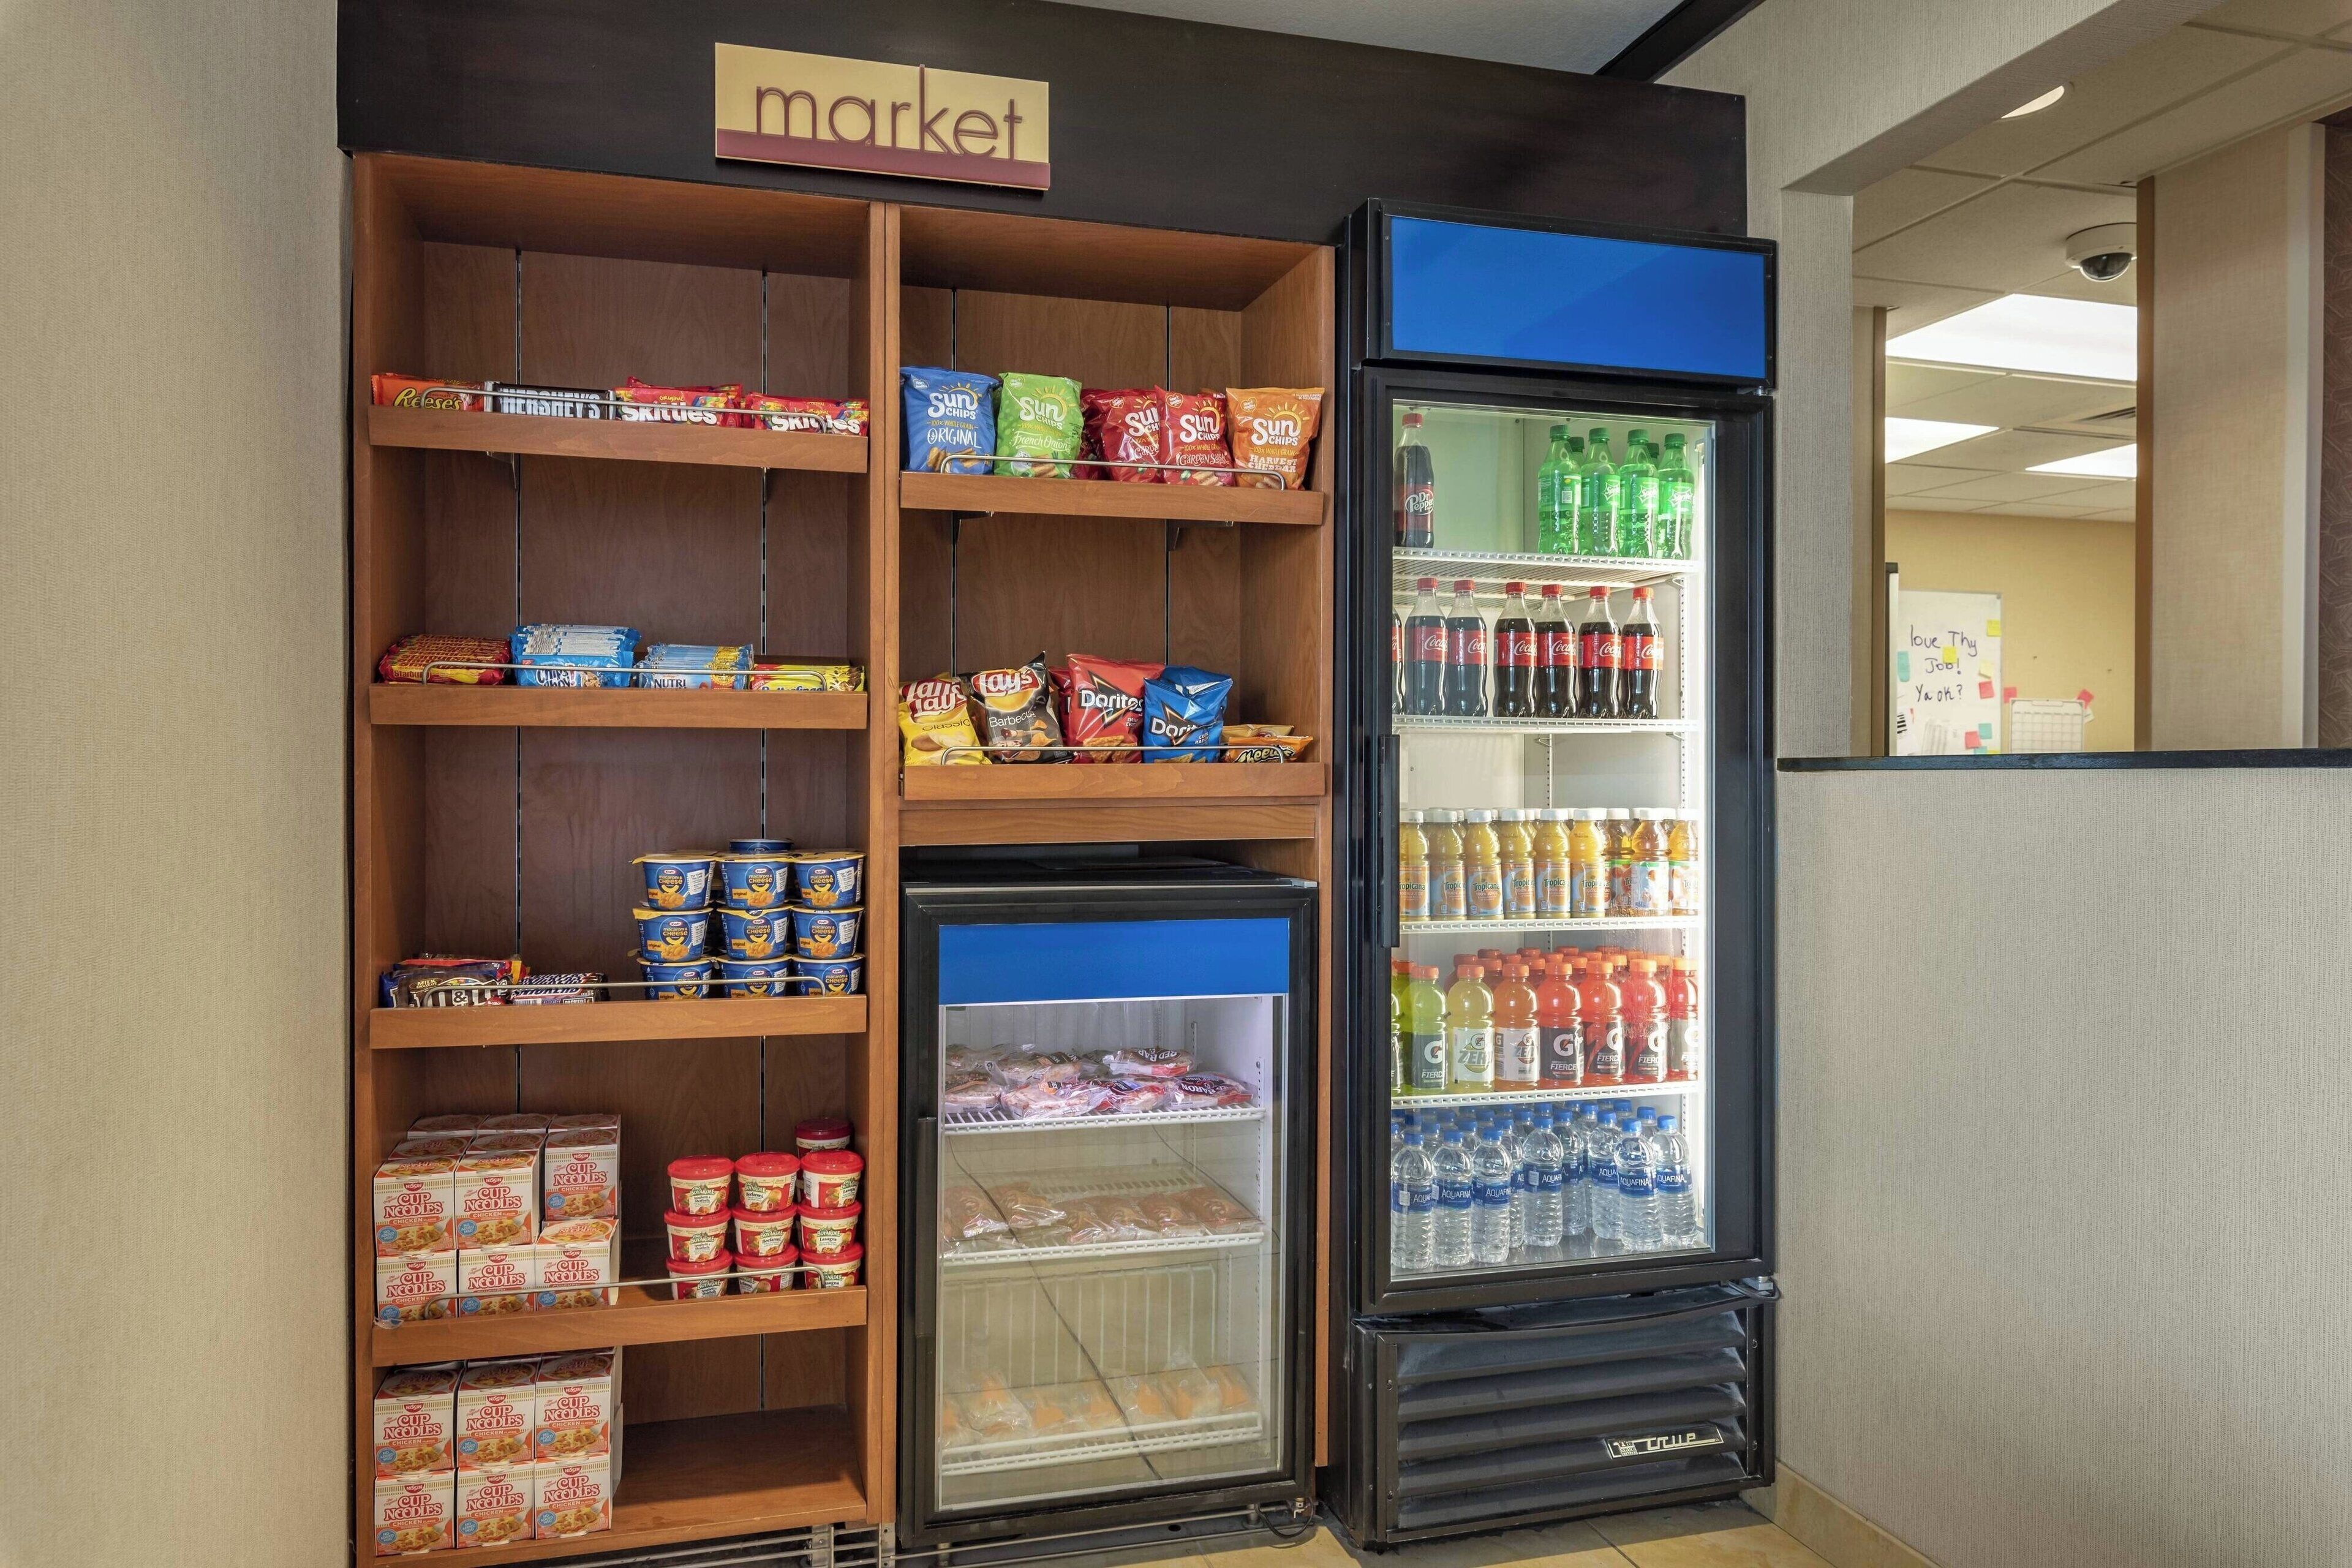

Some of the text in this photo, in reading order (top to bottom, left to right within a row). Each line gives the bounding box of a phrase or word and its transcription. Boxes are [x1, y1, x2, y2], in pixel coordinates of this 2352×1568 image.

[756, 64, 1023, 161] market
[499, 388, 600, 420] HERSHEY'S
[927, 392, 978, 418] Sun
[1019, 396, 1067, 422] Sun
[945, 407, 976, 420] CHIPS
[1036, 415, 1063, 430] CHIPS
[1180, 414, 1220, 443] Sun
[927, 428, 982, 448] ORIGINAL
[1251, 418, 1302, 446] Sun
[1268, 436, 1298, 447] CHIPS
[1248, 462, 1297, 473] CHEDDAR
[1249, 454, 1298, 466] HARVEST
[1419, 492, 1430, 502] Dr
[1948, 631, 1978, 657] Thy
[394, 669, 426, 678] Starbu
[654, 678, 686, 688] NUTRI
[1080, 690, 1144, 713] Doritos
[988, 710, 1036, 728] Barbecue
[1152, 717, 1198, 737] Dorit
[1553, 1034, 1577, 1057] G
[566, 1162, 597, 1175] CUP
[553, 1170, 607, 1186] NOODLES
[1620, 1176, 1651, 1186] AQUAFINA
[398, 1192, 431, 1205] CUP
[478, 1186, 511, 1199] CUP
[1413, 1194, 1431, 1204] AQUAF
[1485, 1188, 1510, 1199] AQUAFIN
[384, 1201, 443, 1218] NOODLES
[464, 1196, 522, 1212] NOODLES
[481, 1264, 514, 1276] CUP
[557, 1259, 589, 1272] CUP
[400, 1271, 434, 1284] CUP
[468, 1273, 526, 1289] NOODLES
[544, 1268, 599, 1283] NOODLES
[386, 1280, 446, 1297] NOODLES
[557, 1396, 589, 1409] CUP
[480, 1404, 513, 1418] CUP
[544, 1404, 600, 1422] NOODLES
[397, 1413, 431, 1427] CUP
[466, 1414, 524, 1431] NOODLES
[383, 1423, 442, 1439] NOODLES
[557, 1475, 589, 1489] CUP
[480, 1483, 513, 1498] CUP
[544, 1483, 600, 1503] NOODLES
[398, 1493, 431, 1507] CUP
[466, 1492, 524, 1511] NOODLES
[384, 1502, 443, 1521] NOODLES
